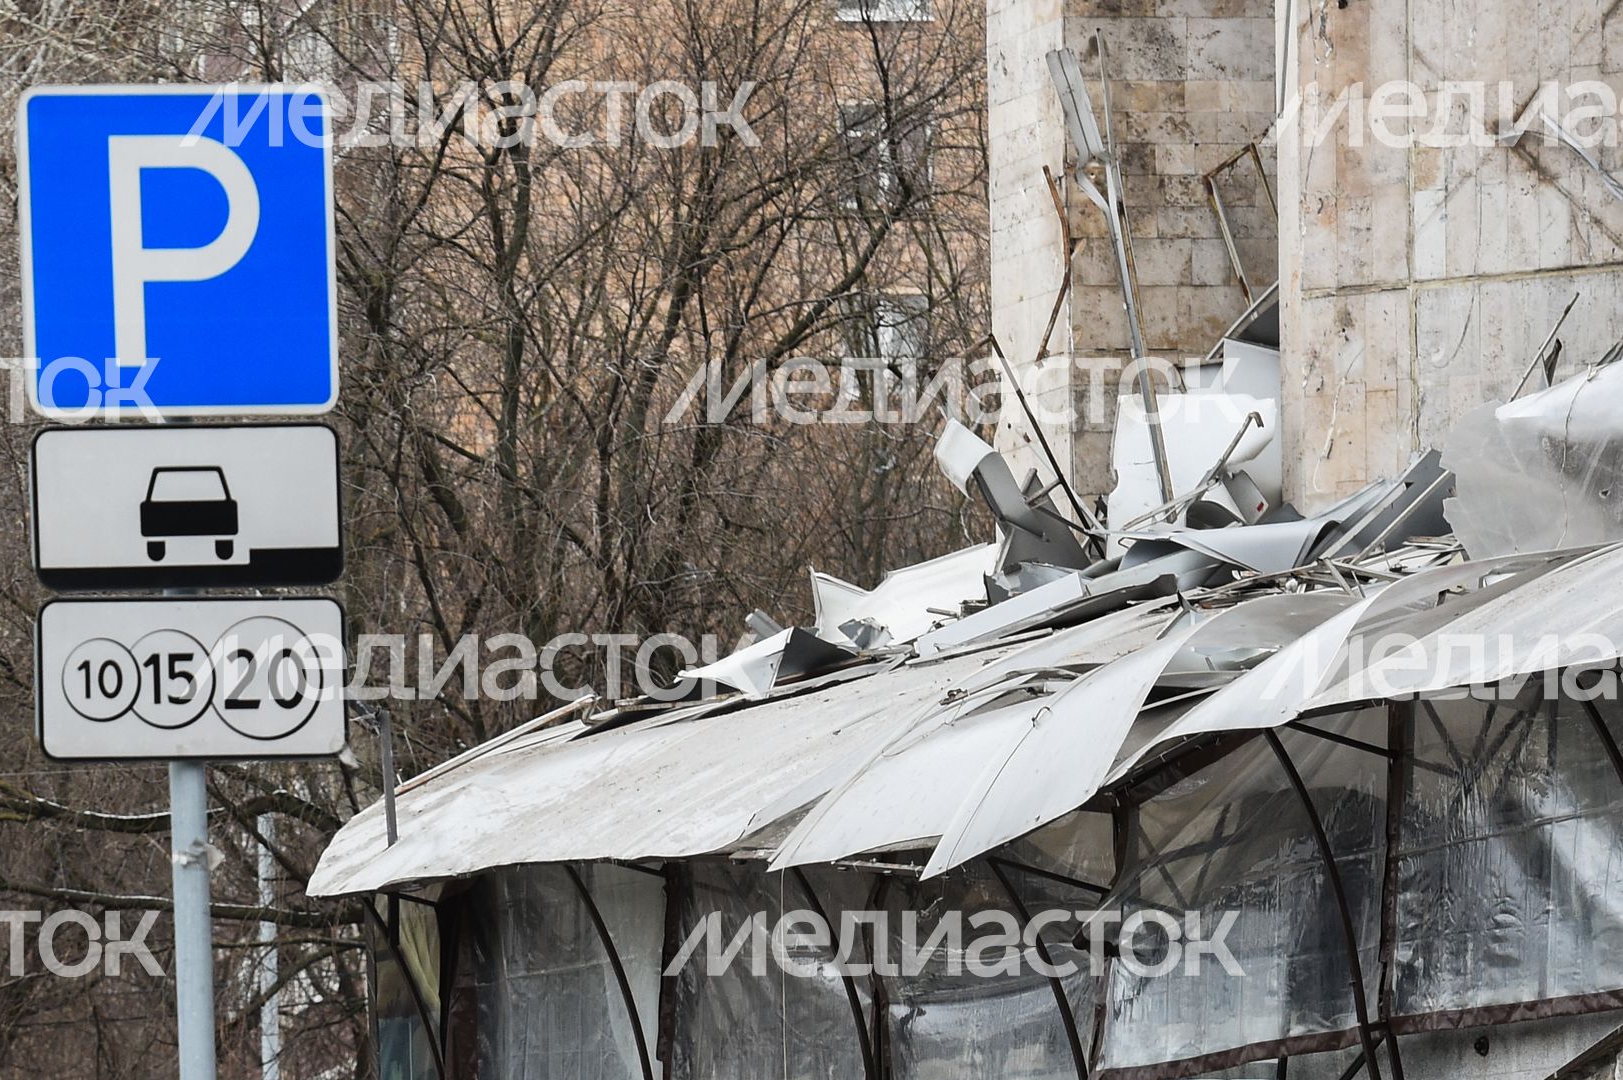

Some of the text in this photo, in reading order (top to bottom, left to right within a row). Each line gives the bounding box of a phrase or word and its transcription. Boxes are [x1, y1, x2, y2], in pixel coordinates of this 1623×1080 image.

[108, 134, 260, 368] P
[77, 660, 123, 699] 10
[143, 653, 197, 705] 15
[225, 648, 306, 709] 20
